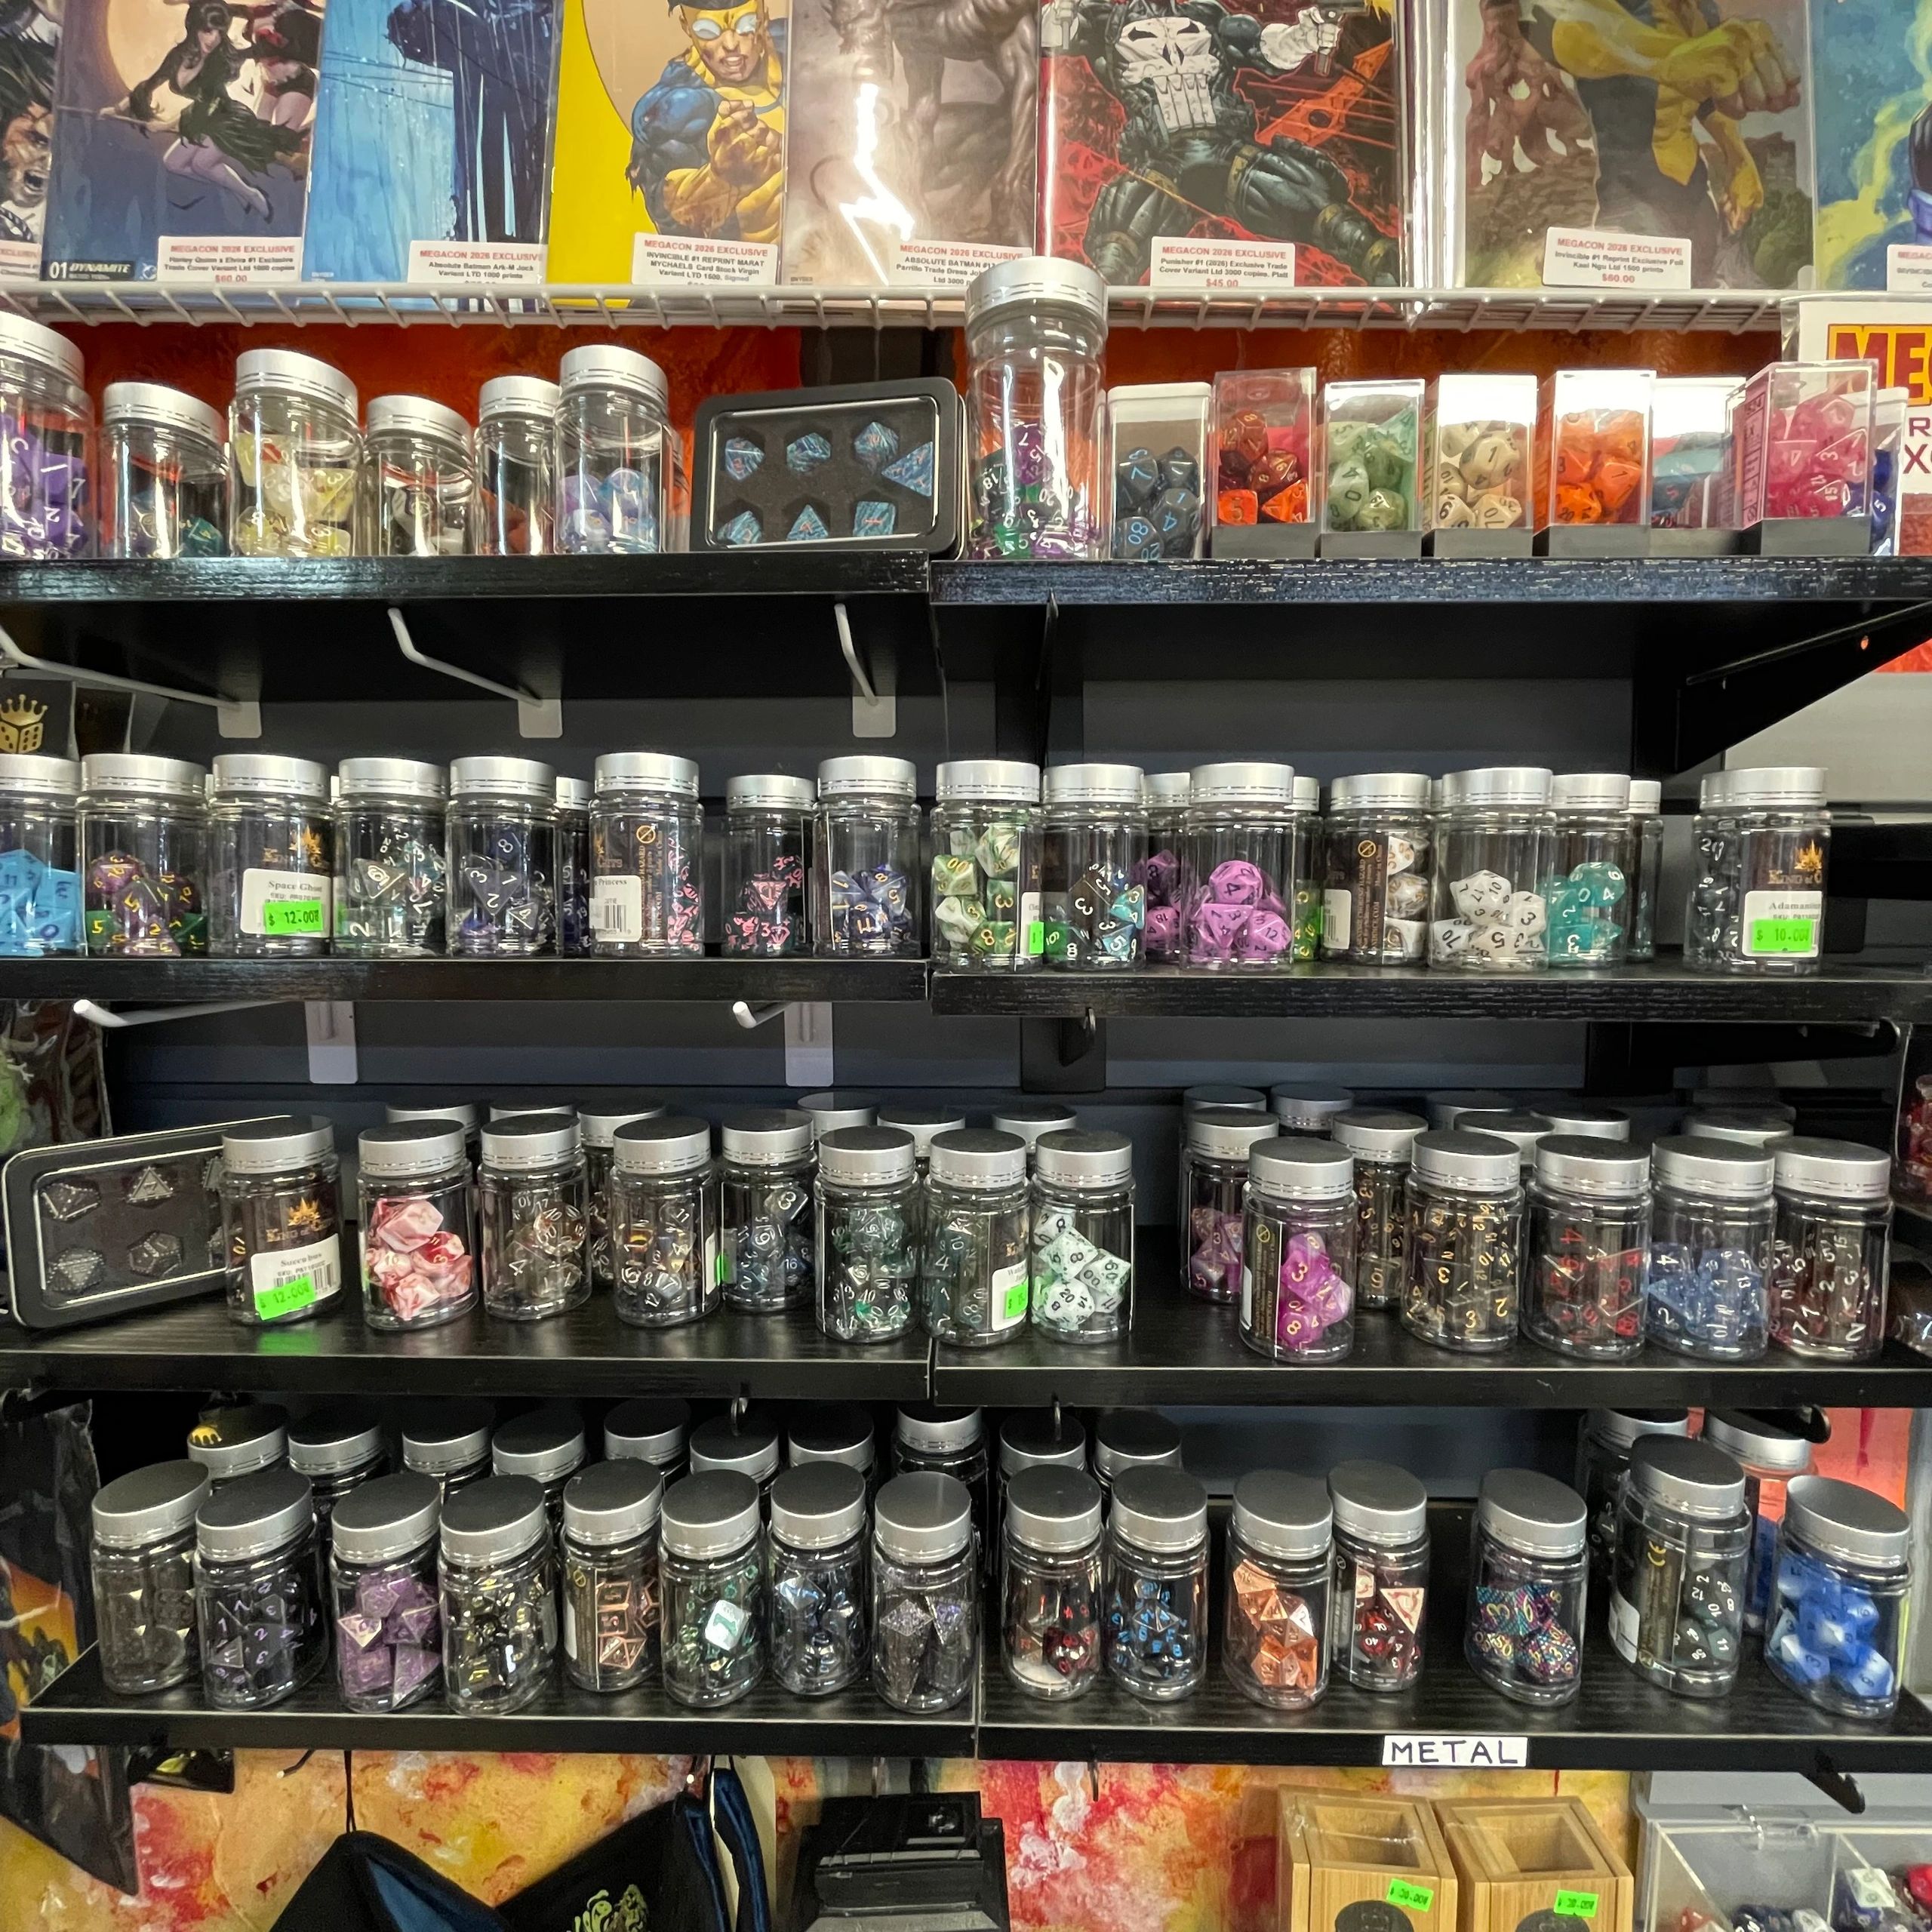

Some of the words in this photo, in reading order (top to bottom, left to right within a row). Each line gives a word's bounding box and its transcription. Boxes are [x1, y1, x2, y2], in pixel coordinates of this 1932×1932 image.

[644, 240, 692, 251] MEGACON
[717, 246, 768, 257] EXCLUSIVE
[900, 245, 947, 254] MEGACON
[950, 248, 970, 257] 2026
[1162, 246, 1209, 255] MEGACON
[1235, 250, 1286, 259] EXCLUSIVE
[1557, 238, 1604, 251] MEGACON
[1630, 245, 1683, 256] EXCLUSIVE
[647, 251, 689, 262] INVINCIBLE
[702, 256, 735, 265] REPRINT
[905, 257, 946, 266] ABSOLUTE
[949, 260, 980, 268] BATMAN
[1555, 251, 1589, 260] Invincible
[50, 262, 67, 278] 01
[69, 263, 131, 273] DYNAMITE
[1826, 324, 1932, 406] ME
[498, 838, 513, 853] 8
[269, 881, 296, 890] Space
[1266, 928, 1278, 939] 12
[1110, 936, 1127, 952] 5
[785, 1258, 798, 1269] 16
[935, 1254, 949, 1271] 4
[1059, 1288, 1075, 1303] 20
[1466, 1310, 1476, 1328] 3
[1287, 1320, 1302, 1335] 8
[1392, 1740, 1518, 1764] METAL
